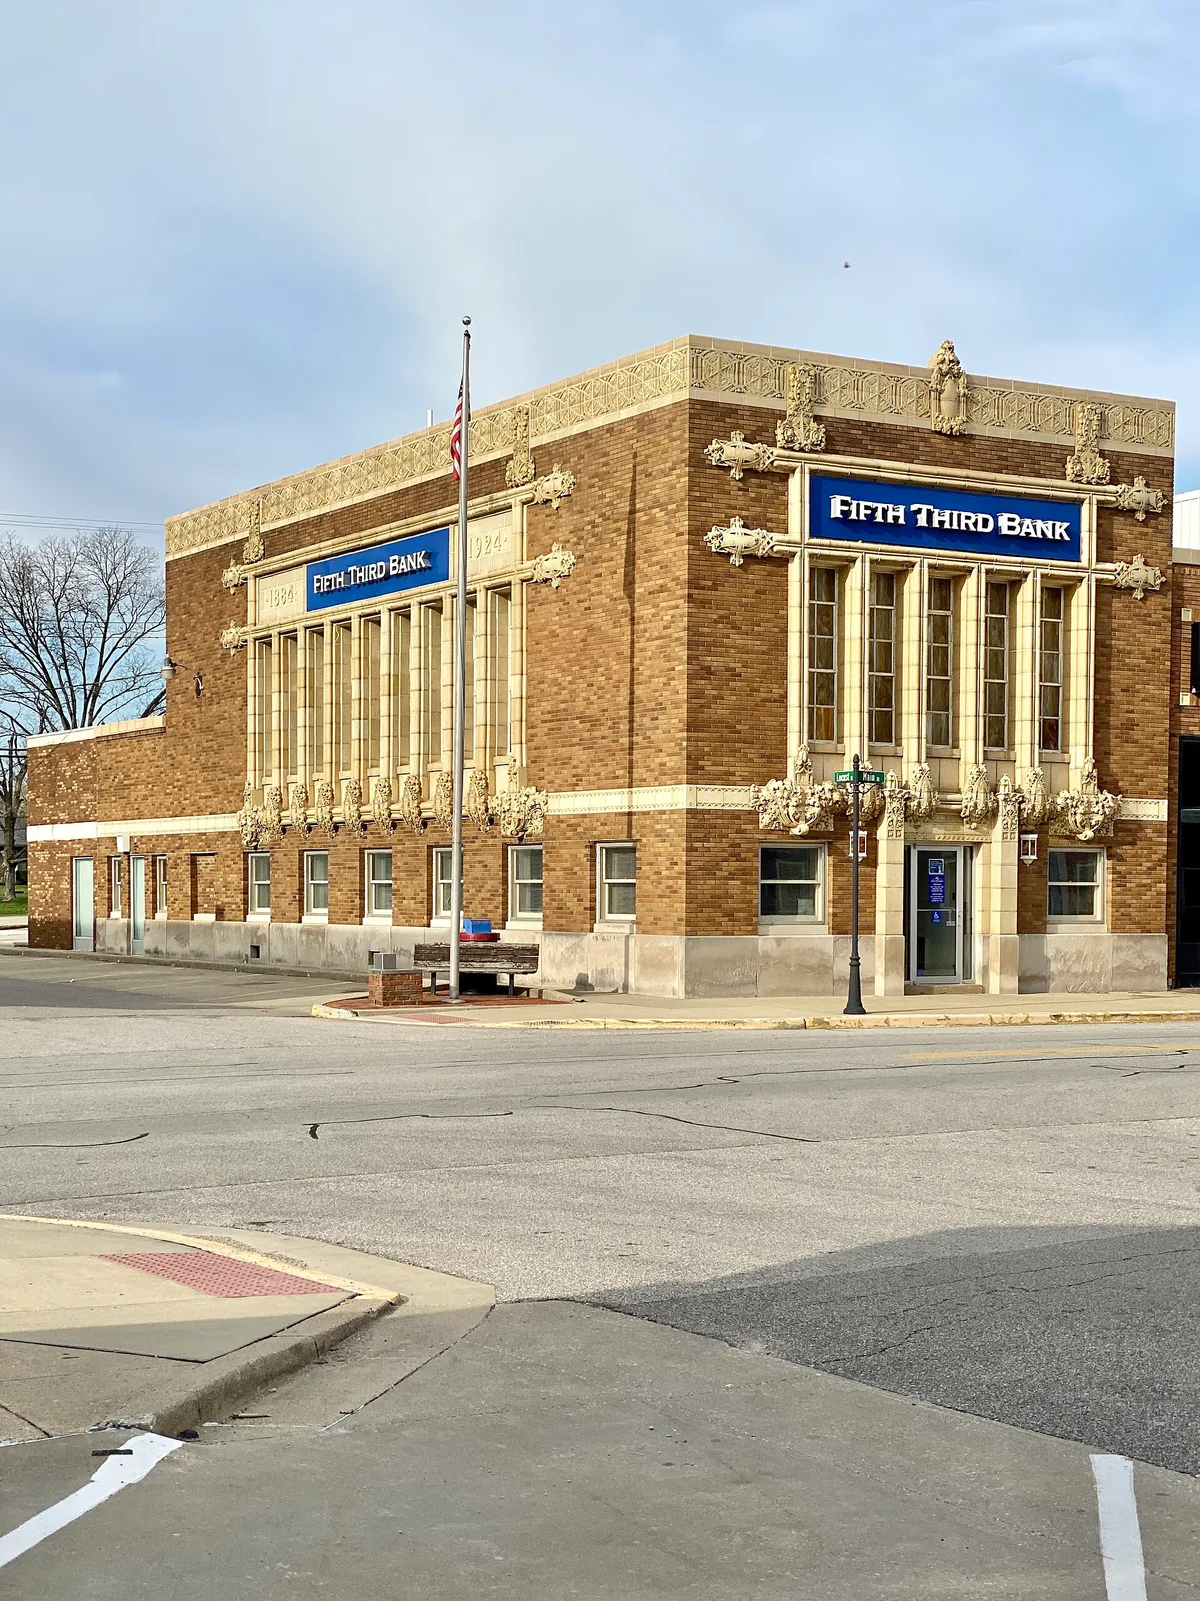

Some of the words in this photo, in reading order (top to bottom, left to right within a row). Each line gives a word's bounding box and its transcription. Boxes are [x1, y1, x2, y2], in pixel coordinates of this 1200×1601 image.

[829, 494, 906, 524] FIFTH
[910, 503, 994, 533] THIRD
[997, 512, 1071, 541] BANK
[313, 571, 345, 594] FIFTH
[348, 561, 386, 586] THIRD
[389, 550, 428, 574] BANK
[862, 772, 876, 782] Main
